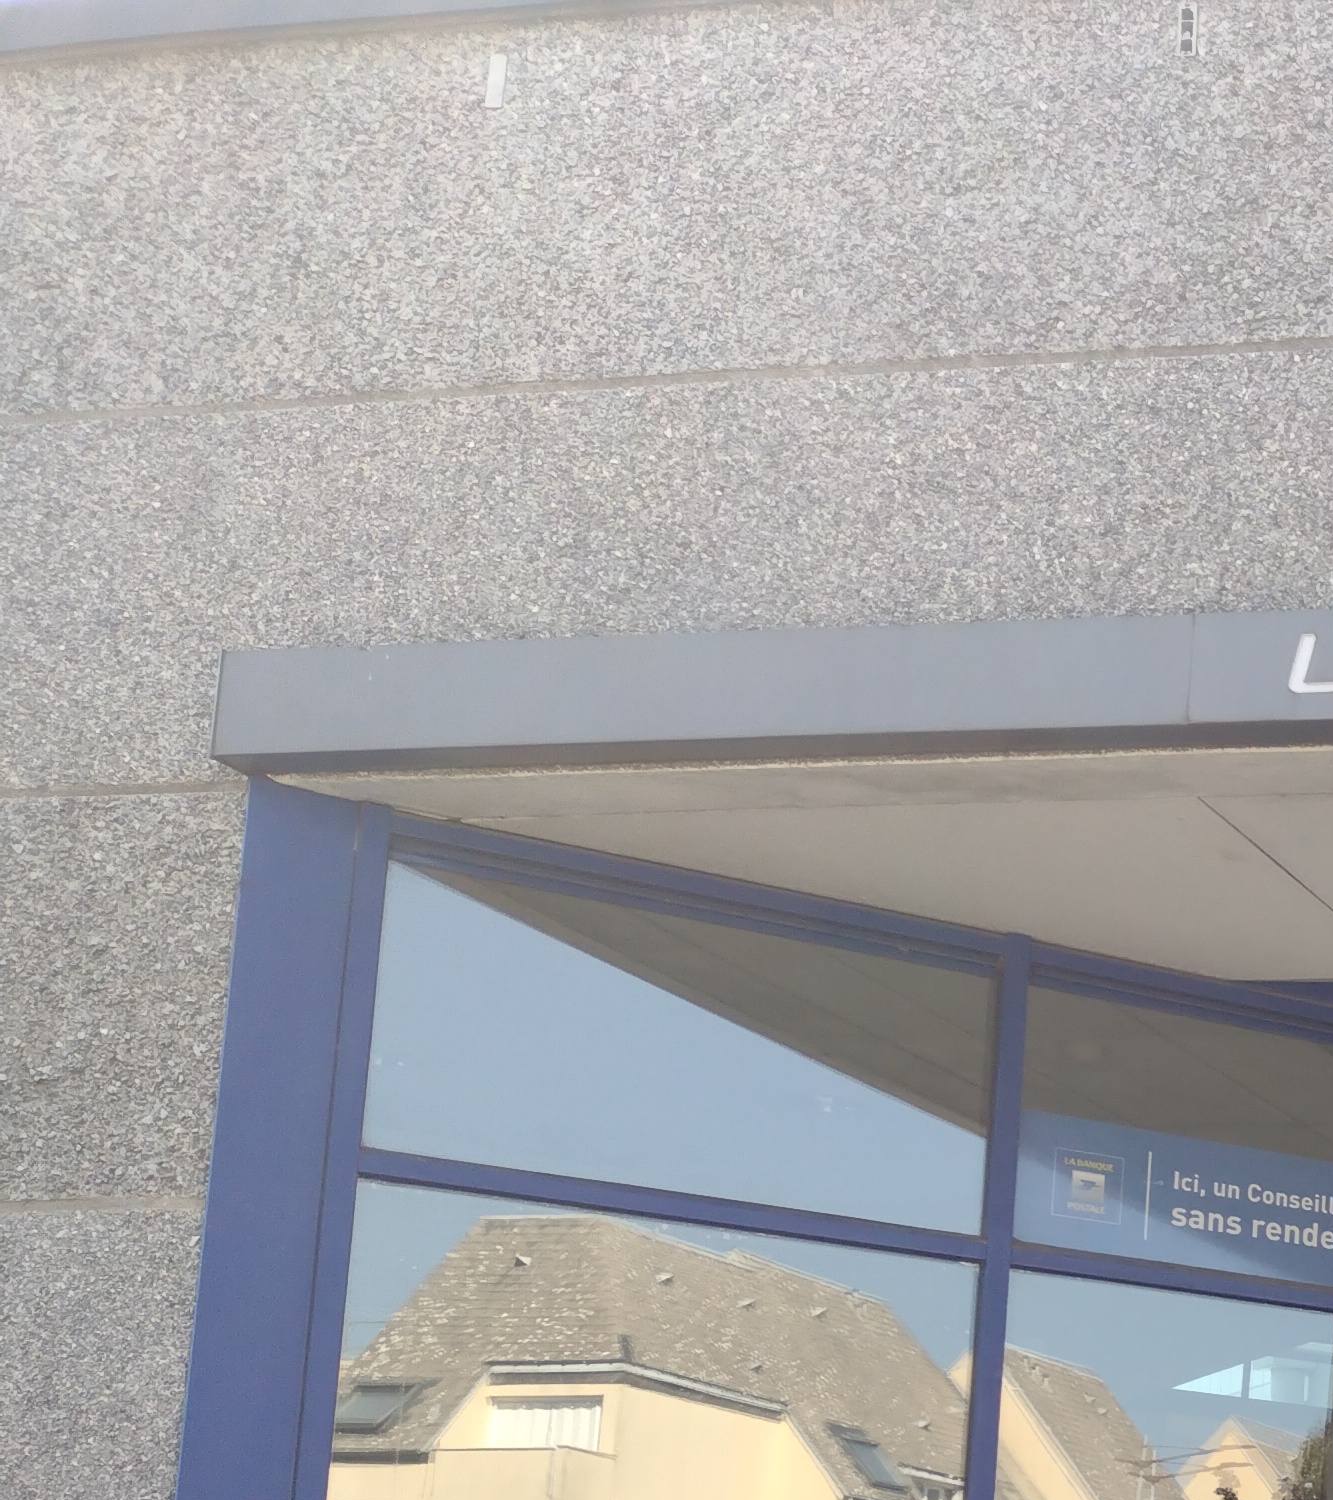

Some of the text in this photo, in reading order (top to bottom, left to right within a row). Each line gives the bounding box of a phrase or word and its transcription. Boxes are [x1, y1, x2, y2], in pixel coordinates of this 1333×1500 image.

[1172, 1170, 1207, 1198] Ici,
[1213, 1181, 1241, 1200] un
[1170, 1206, 1242, 1236] sans
